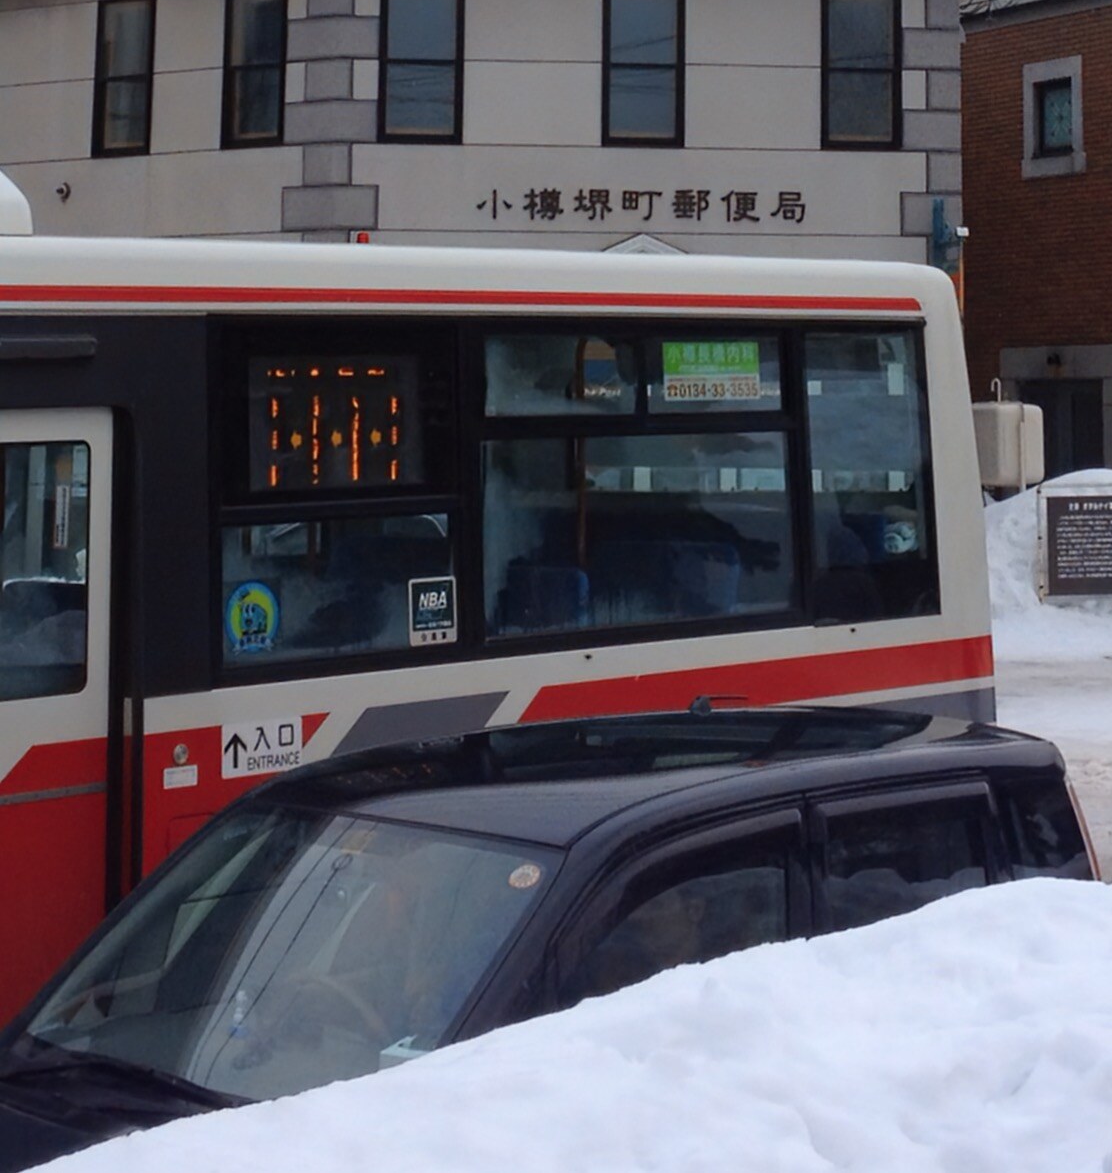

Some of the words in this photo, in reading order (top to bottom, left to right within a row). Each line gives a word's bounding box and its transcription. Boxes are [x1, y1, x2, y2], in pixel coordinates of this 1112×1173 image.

[476, 188, 806, 223] 小樽堺町郵便局
[419, 591, 447, 608] NBA
[253, 723, 294, 752] 入口
[247, 751, 300, 771] ENTRANCE
